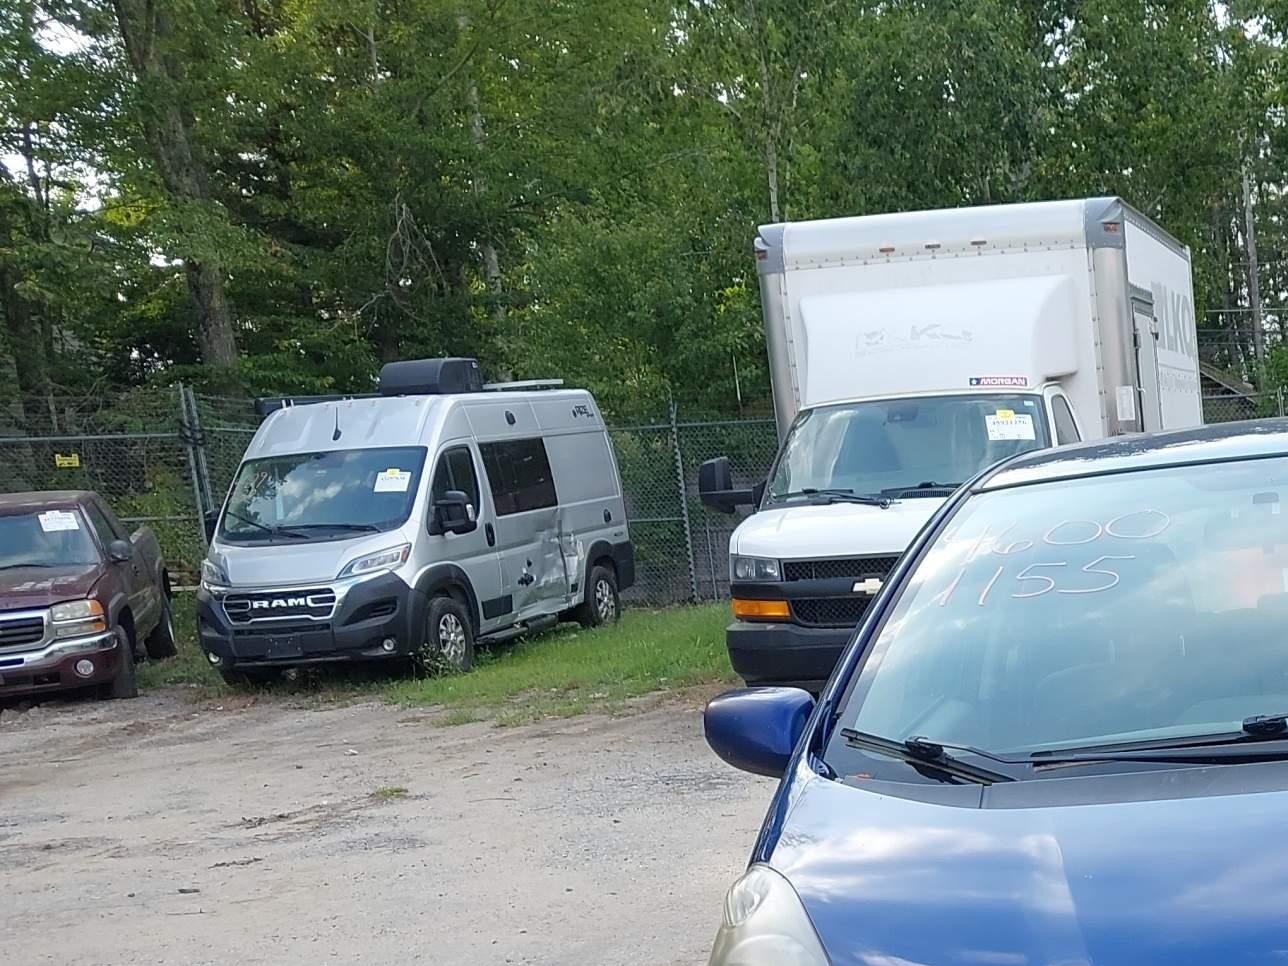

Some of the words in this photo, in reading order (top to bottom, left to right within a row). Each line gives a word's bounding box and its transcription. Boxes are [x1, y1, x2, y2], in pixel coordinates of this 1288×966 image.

[980, 378, 1026, 386] MORGAN
[943, 508, 1170, 566] 4600
[930, 555, 1136, 607] 1155
[252, 597, 305, 609] RAM
